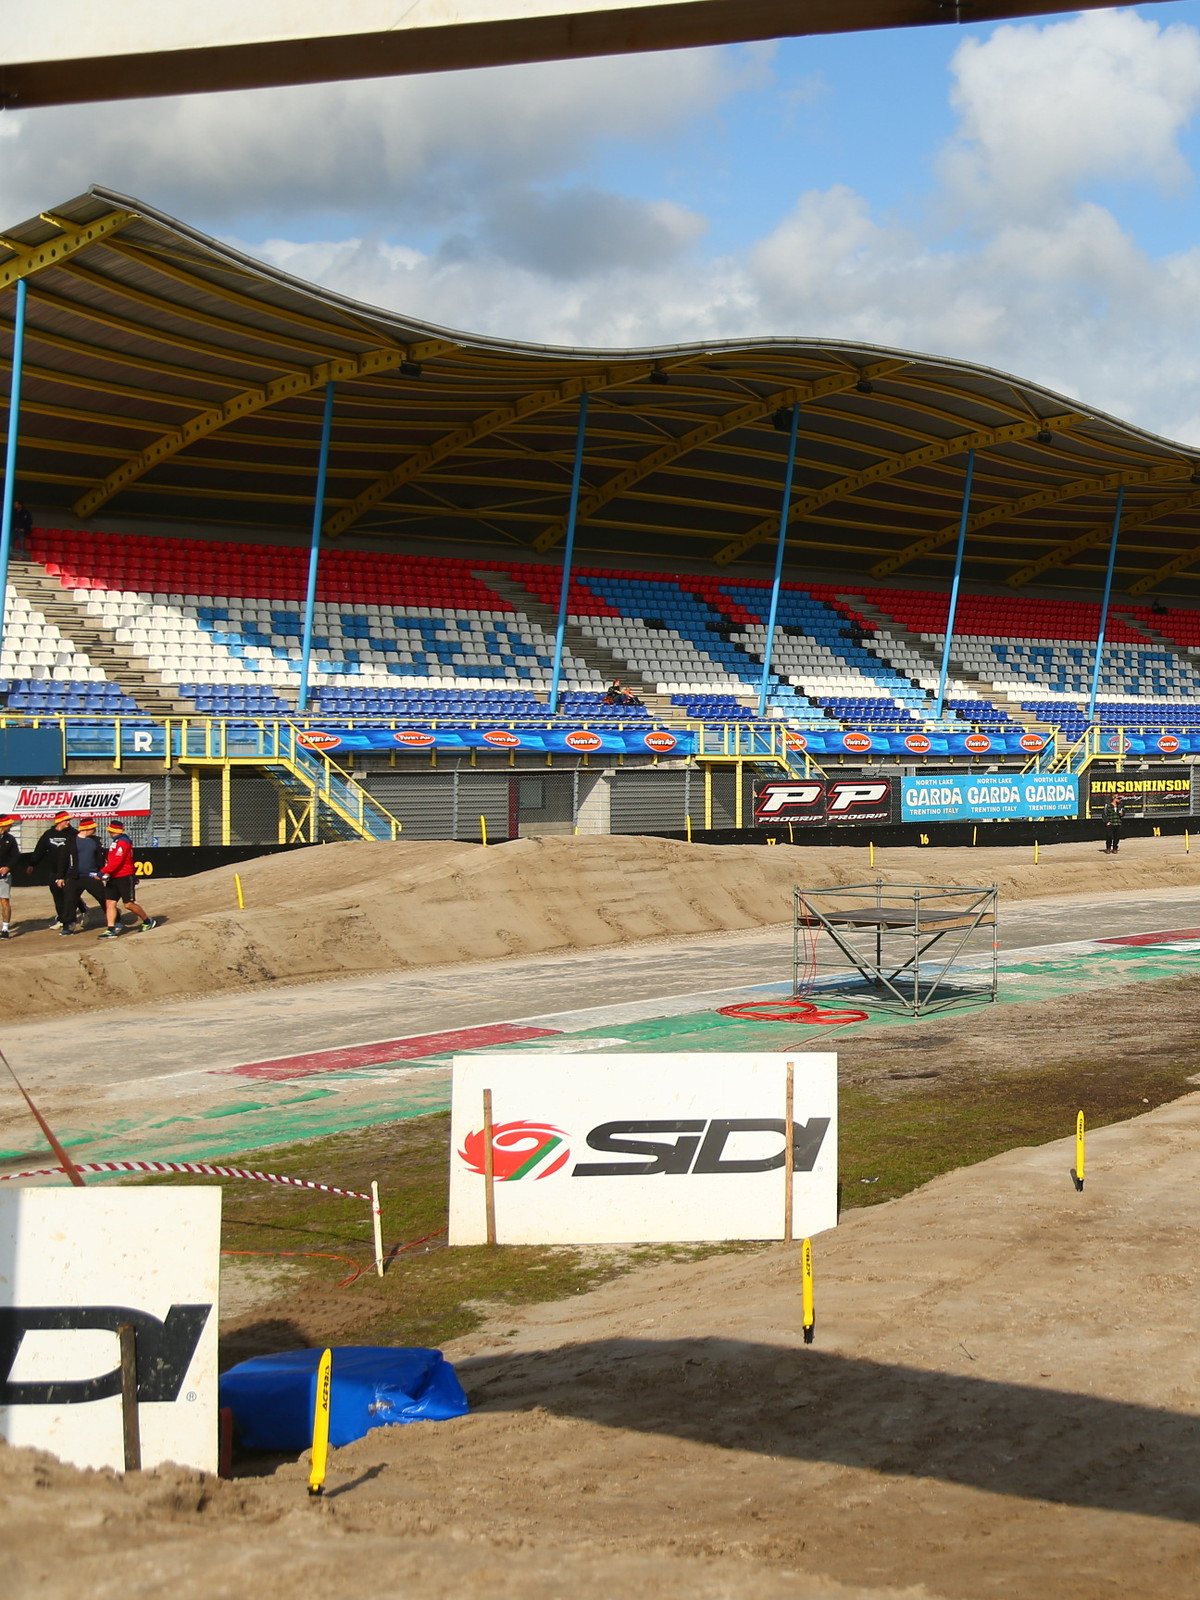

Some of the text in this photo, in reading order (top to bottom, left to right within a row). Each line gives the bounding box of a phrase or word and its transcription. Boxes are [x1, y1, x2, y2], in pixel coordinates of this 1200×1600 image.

[134, 731, 153, 752] R
[569, 737, 600, 745] Twin Air
[647, 737, 664, 745] Twin
[967, 785, 1021, 804] GARDA
[1025, 784, 1076, 803] GARDA
[1091, 779, 1190, 793] HINSON HINSON
[762, 786, 822, 812] P
[831, 784, 888, 810] P
[906, 786, 963, 807] GARDA
[758, 815, 823, 823] PROGRIP
[828, 812, 888, 821] PROGRIP
[919, 833, 930, 845] 16
[134, 861, 153, 876] 20
[571, 1116, 832, 1177] SIDI
